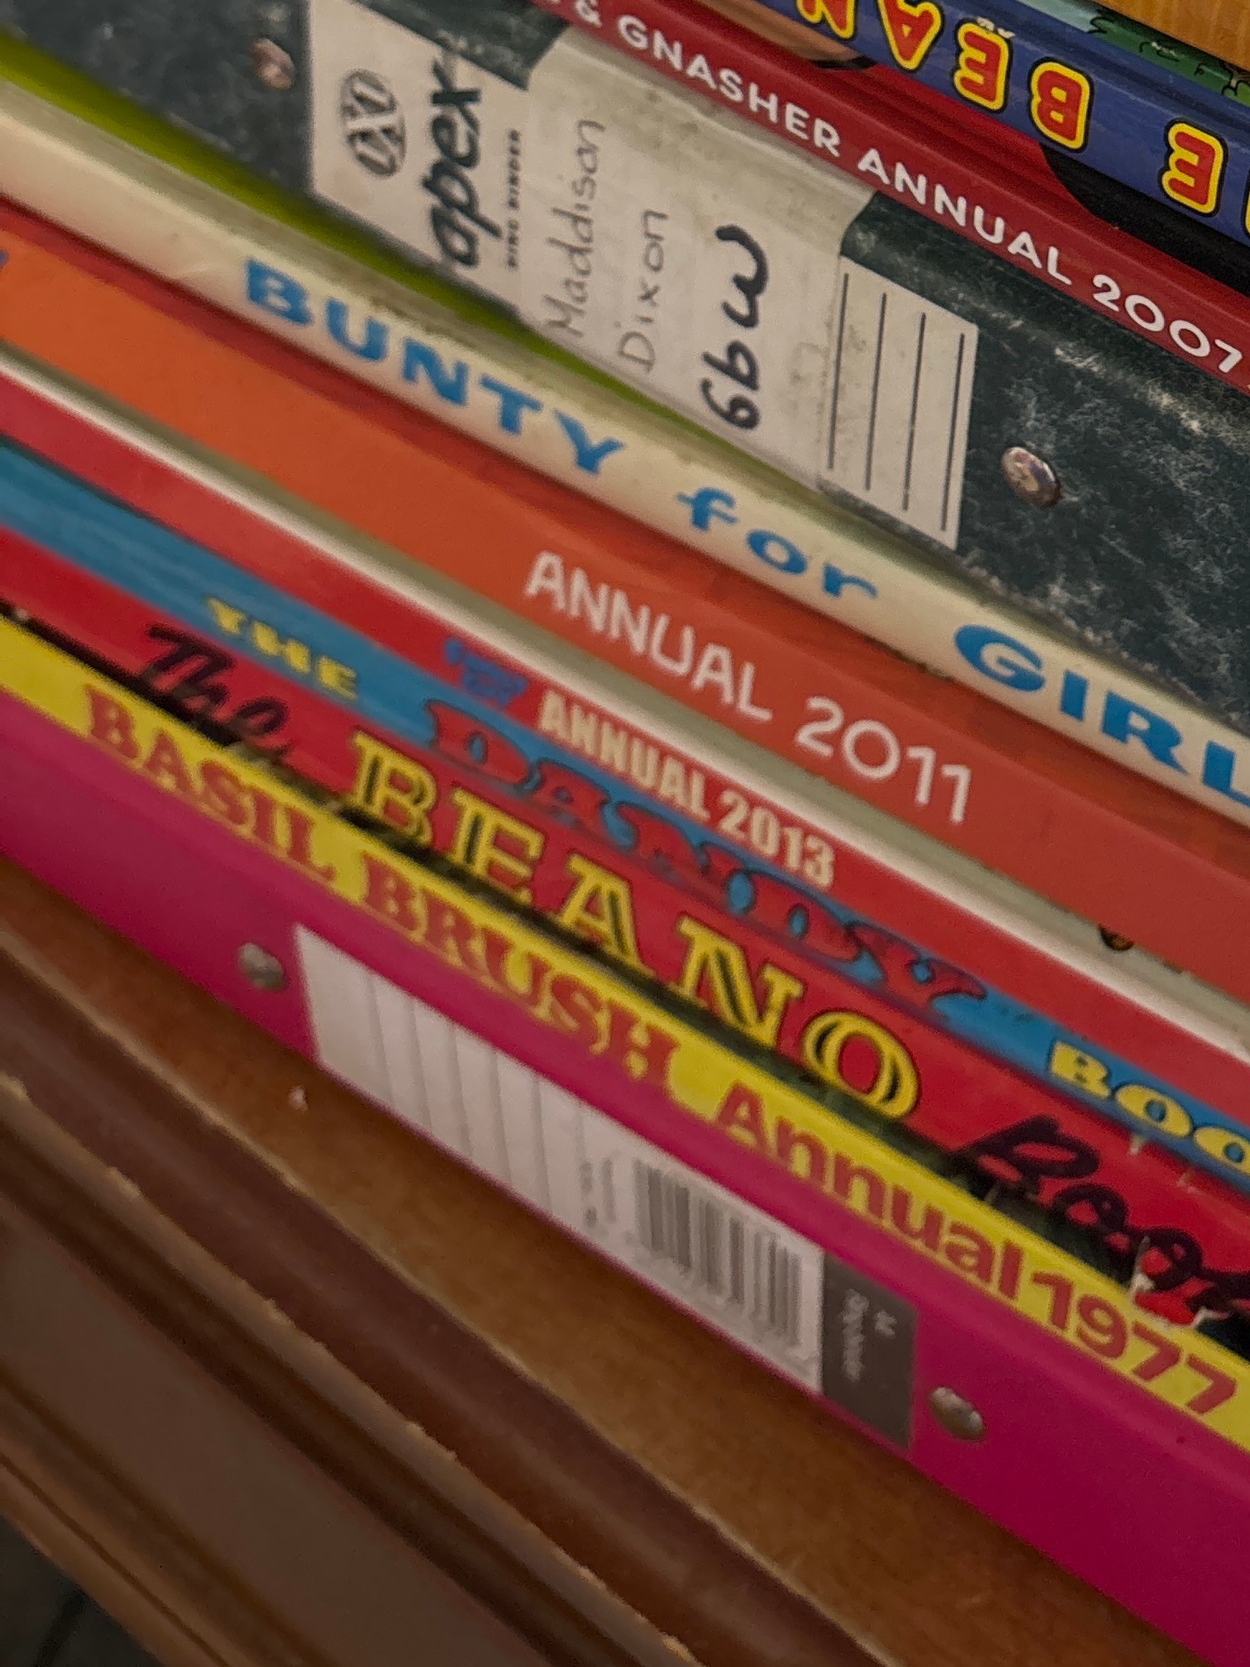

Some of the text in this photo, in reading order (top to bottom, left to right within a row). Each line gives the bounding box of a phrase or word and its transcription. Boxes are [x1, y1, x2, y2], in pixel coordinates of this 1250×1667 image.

[421, 56, 502, 268] apex
[540, 118, 607, 338] Maddison
[617, 12, 841, 158] GNASHER
[857, 143, 1072, 283] ANNUAL
[1094, 273, 1245, 374] 2007
[619, 208, 669, 374] Dixon
[243, 257, 627, 475] BUNTY
[677, 486, 878, 600] for
[207, 597, 357, 701] THE
[423, 698, 987, 1004] DANDY
[524, 551, 773, 721] ANNUAL
[795, 697, 972, 824] 2011
[538, 690, 711, 821] ANNUAL
[717, 790, 836, 890] 2013
[143, 625, 293, 759] The
[350, 730, 921, 1118] BEANO
[85, 683, 340, 883] BASIL
[360, 849, 680, 1079] BRUSH
[711, 1082, 1023, 1298] Annual
[1030, 1273, 1237, 1416] 1977
